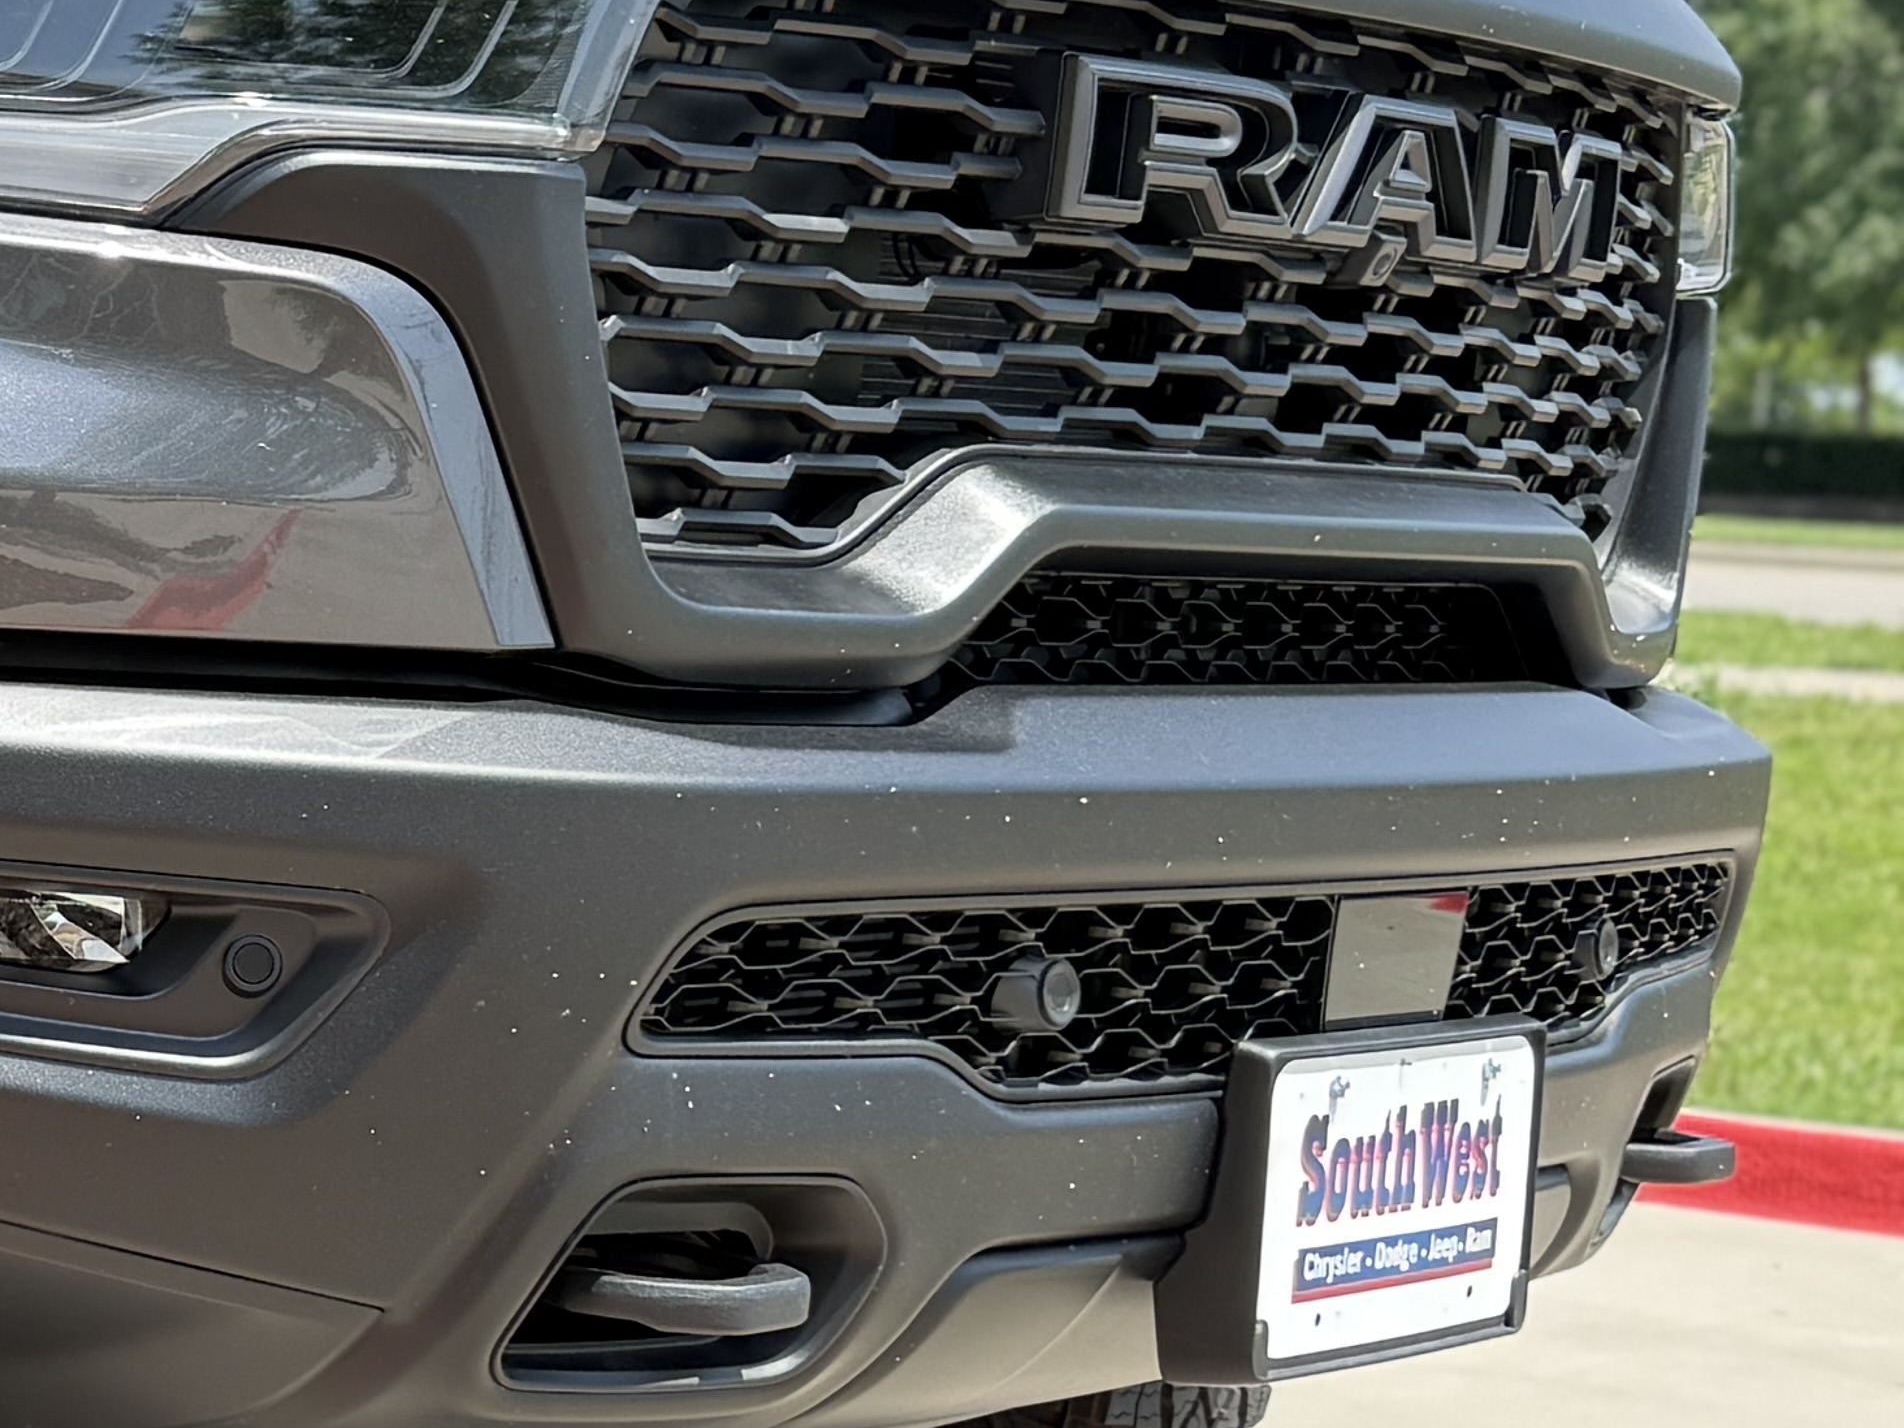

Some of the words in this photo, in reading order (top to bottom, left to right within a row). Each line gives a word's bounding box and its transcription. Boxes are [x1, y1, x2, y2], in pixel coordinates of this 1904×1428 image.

[1047, 52, 1623, 283] RAM
[1303, 1247, 1364, 1283] Chrysler
[1374, 1240, 1419, 1271] Dodge
[1428, 1233, 1459, 1262] Jeep
[1466, 1227, 1493, 1253] Ram
